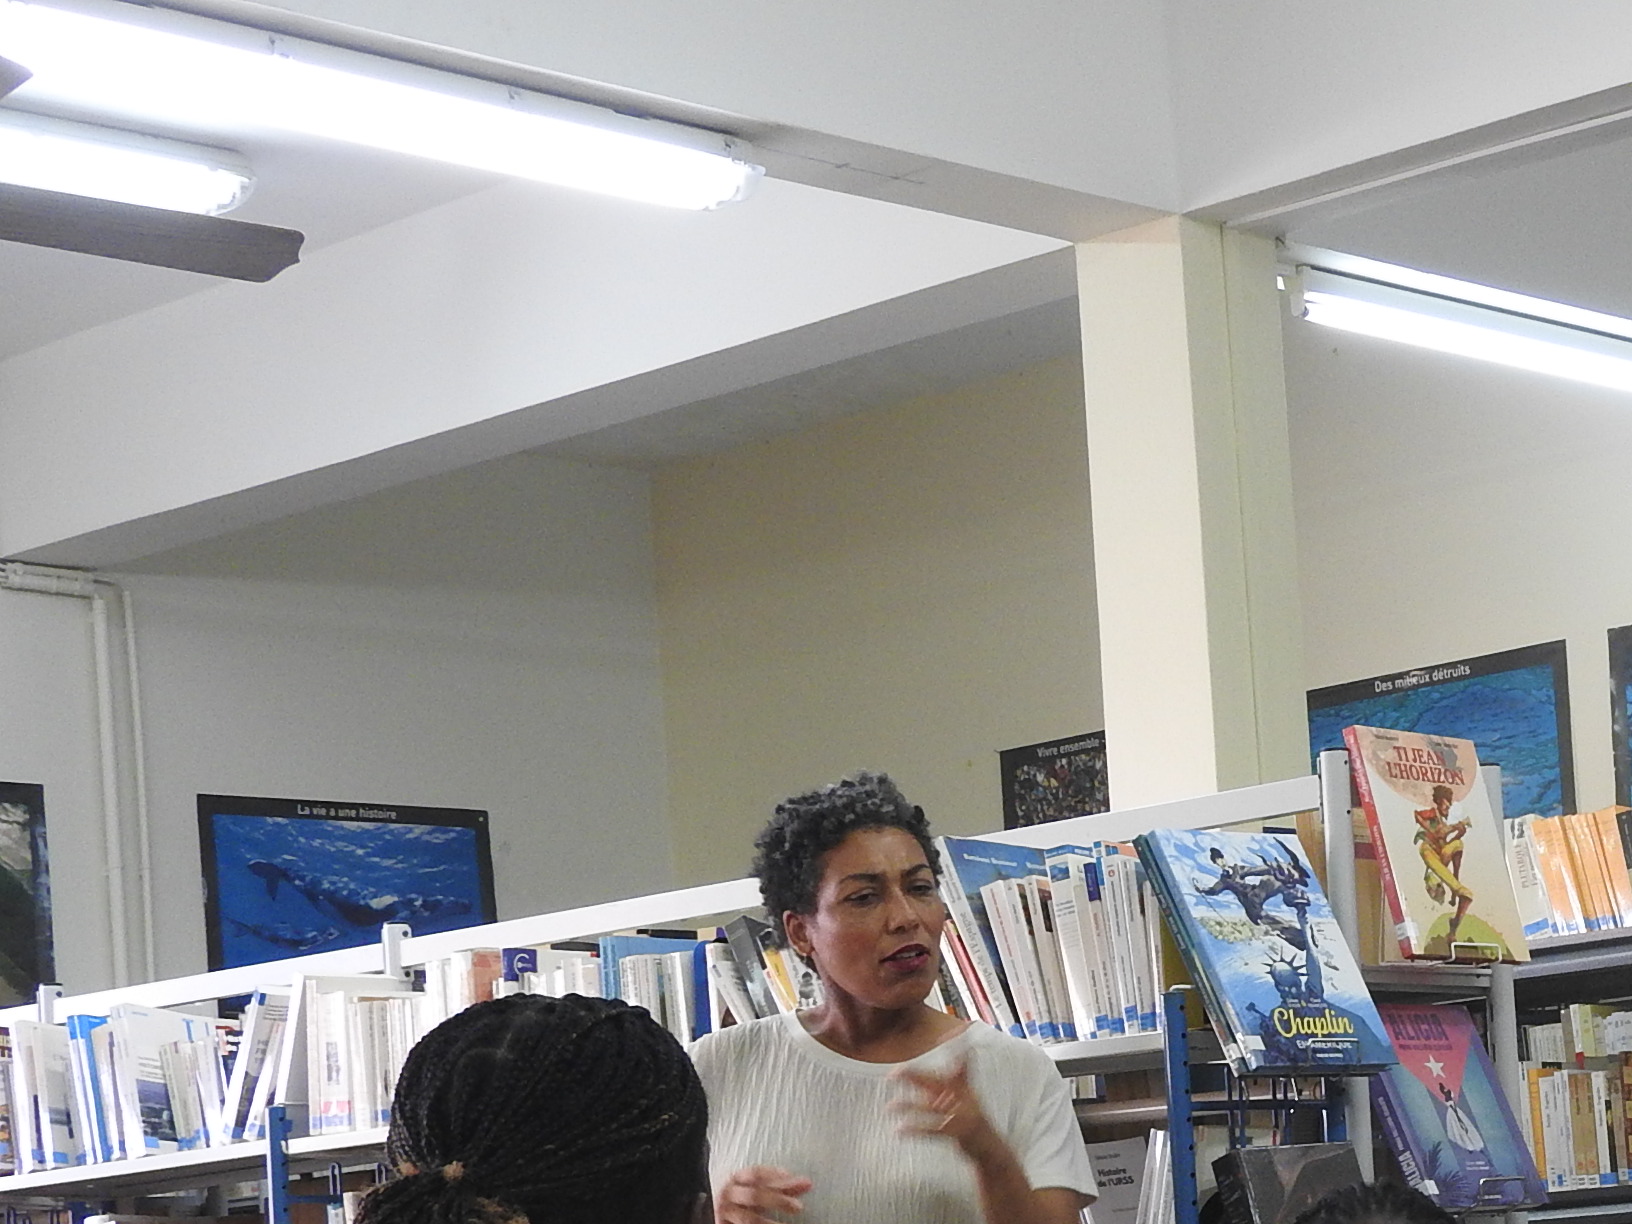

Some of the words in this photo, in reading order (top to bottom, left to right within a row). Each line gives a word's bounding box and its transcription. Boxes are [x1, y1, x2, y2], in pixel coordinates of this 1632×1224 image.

[1374, 678, 1393, 693] Des
[1432, 664, 1471, 683] détruits
[1393, 746, 1410, 763] TI
[1411, 747, 1447, 767] JEAN
[1386, 761, 1465, 786] L'HORIZON
[297, 803, 310, 815] La
[312, 805, 327, 816] vie
[338, 808, 357, 818] une
[359, 807, 397, 820] histoire
[1273, 1007, 1354, 1038] Chaplin
[1097, 1167, 1127, 1177] Histoire
